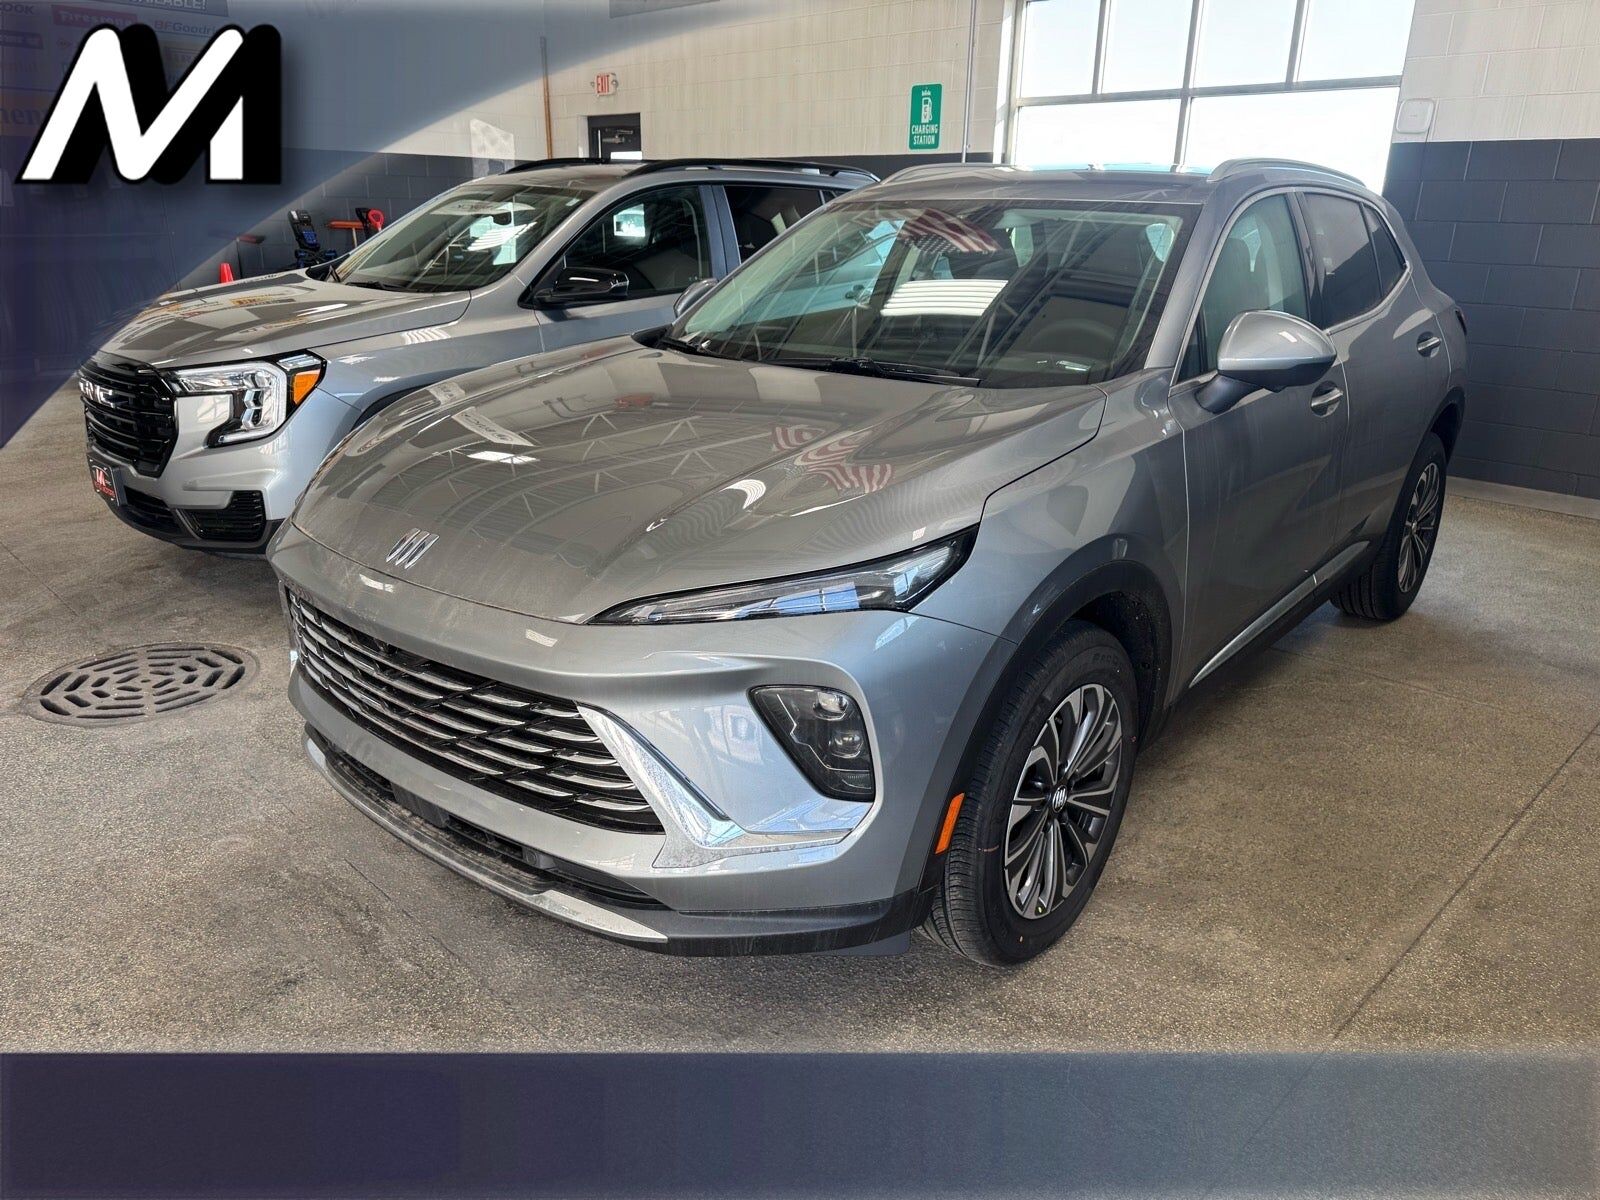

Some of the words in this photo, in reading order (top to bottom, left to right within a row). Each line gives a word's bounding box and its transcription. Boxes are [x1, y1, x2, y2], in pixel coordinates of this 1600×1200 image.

[0, 3, 34, 15] OOK
[153, 19, 217, 35] BFGoodri
[596, 74, 610, 94] EXIT
[911, 124, 938, 135] CHARGING
[913, 135, 935, 145] STATION
